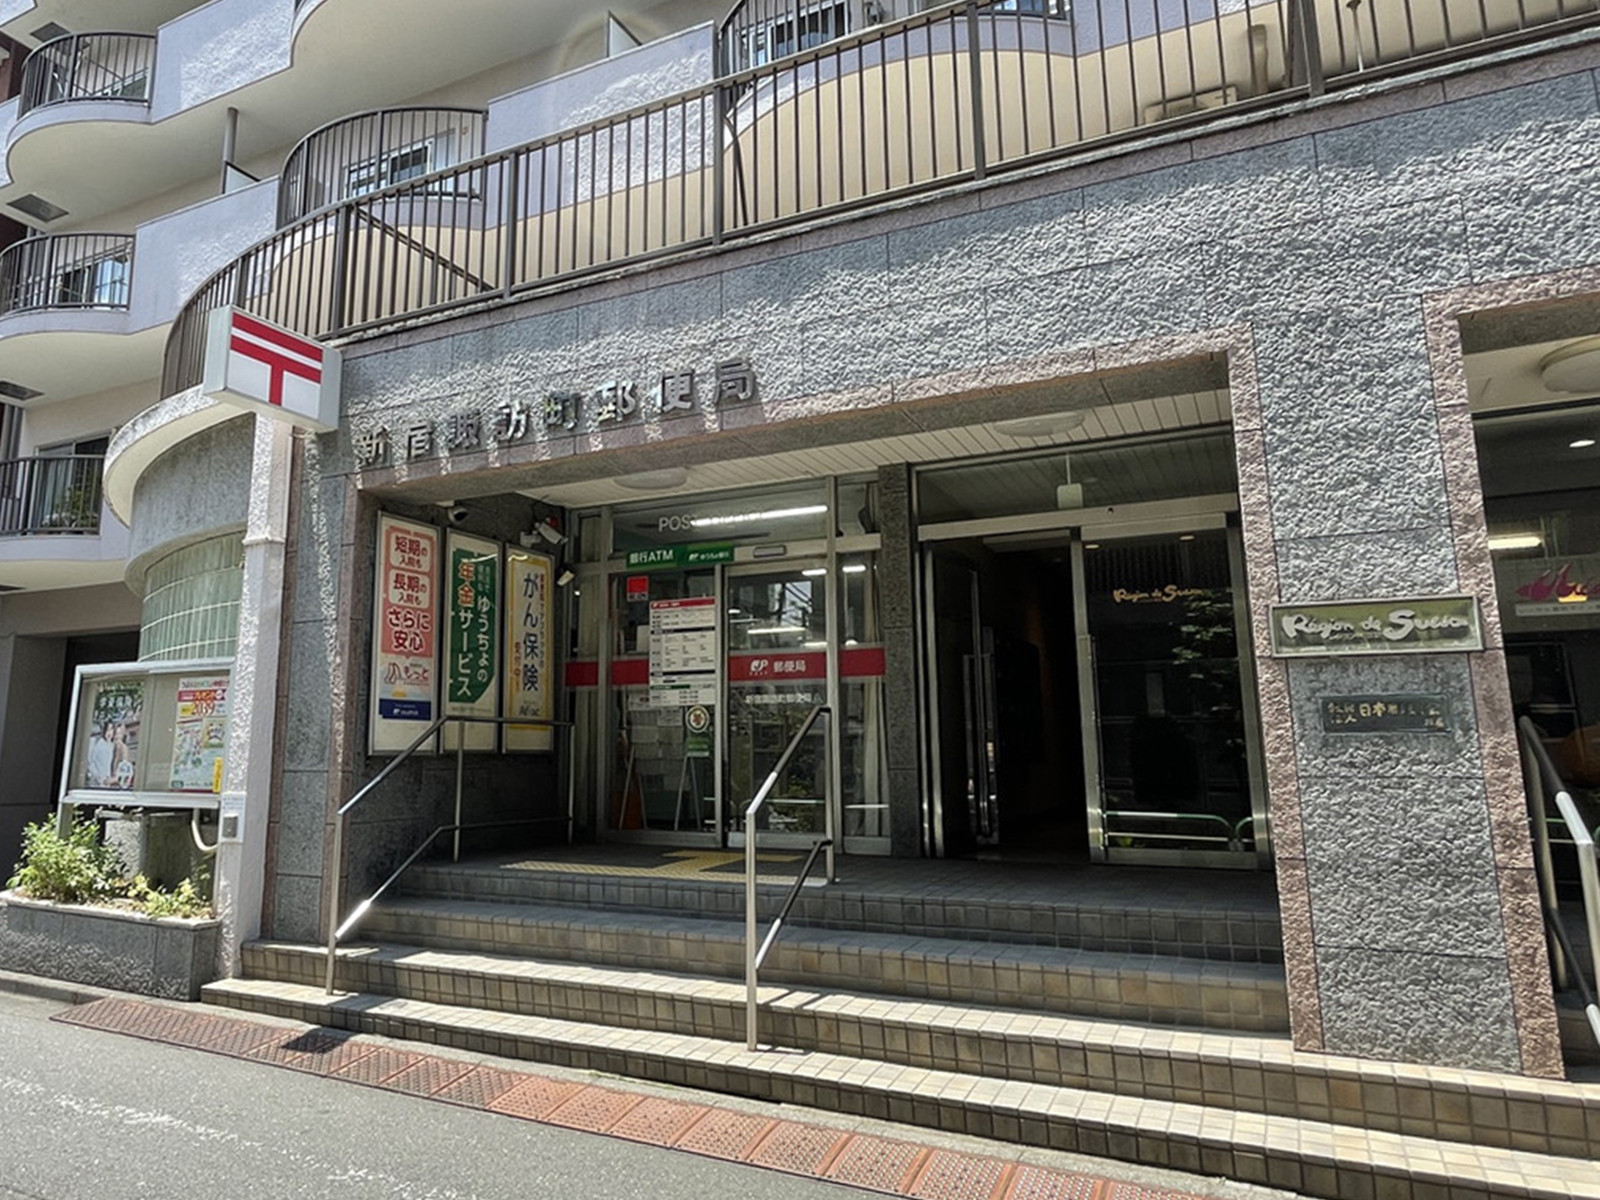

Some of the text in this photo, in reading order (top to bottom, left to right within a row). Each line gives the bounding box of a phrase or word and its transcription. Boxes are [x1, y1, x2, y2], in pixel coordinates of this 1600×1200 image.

[395, 535, 428, 557] 短期の
[394, 573, 427, 593] 長期の
[388, 608, 430, 630] さらに
[457, 559, 474, 697] 年金サービス
[1361, 616, 1382, 632] de
[394, 630, 424, 651] 安心
[477, 595, 491, 683] ゆうちょの
[523, 573, 538, 691] がん保険
